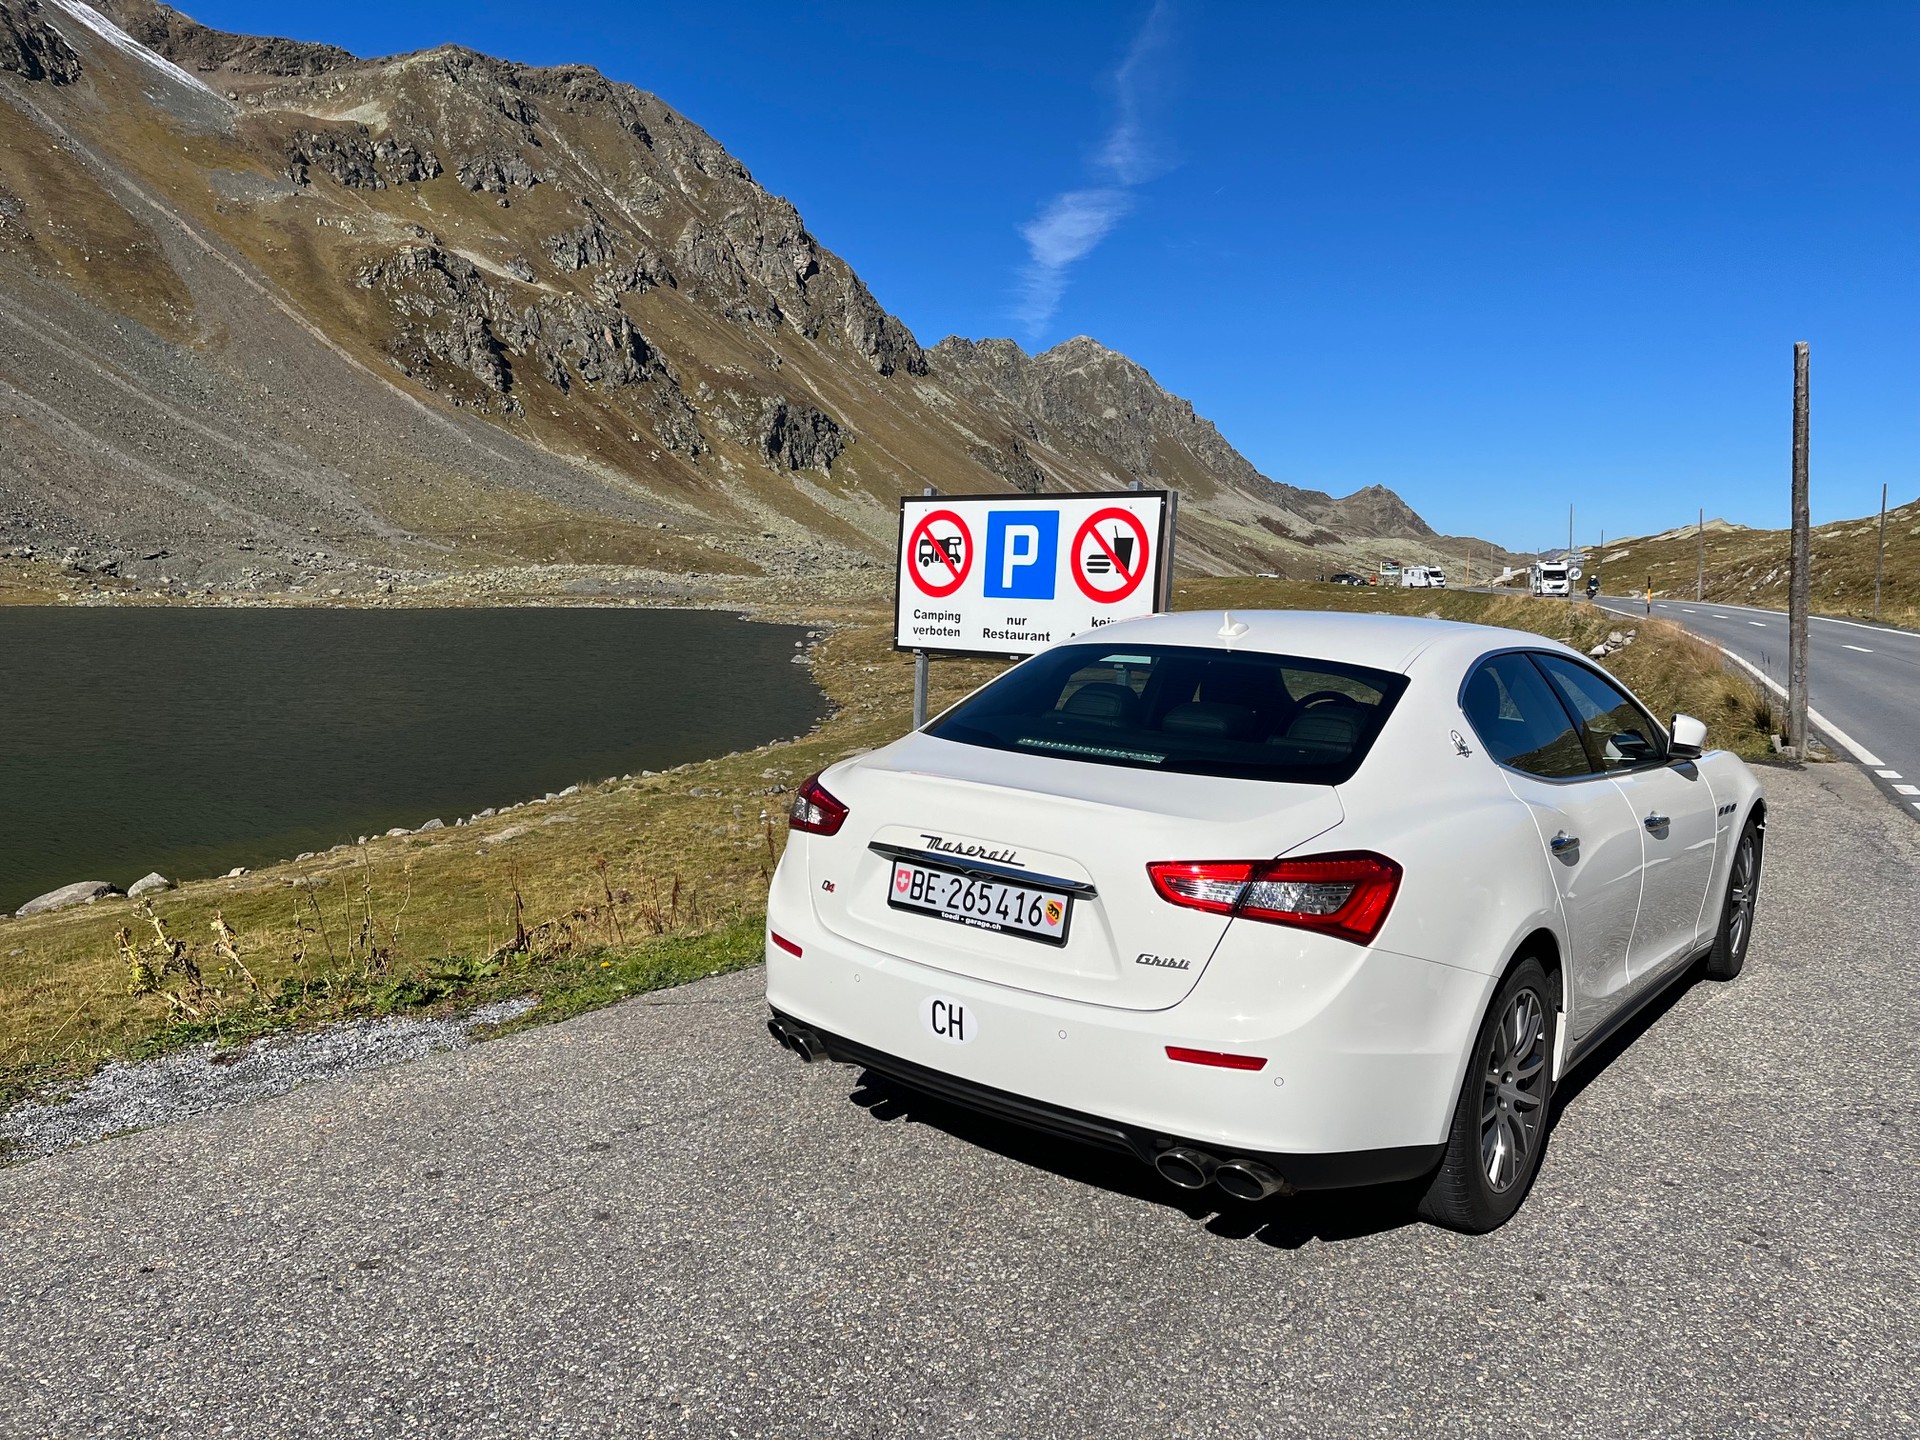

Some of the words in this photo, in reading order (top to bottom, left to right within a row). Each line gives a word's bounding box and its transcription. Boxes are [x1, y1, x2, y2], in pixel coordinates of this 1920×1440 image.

[1002, 524, 1039, 589] P
[913, 609, 961, 624] Camping
[1006, 615, 1027, 626] nur
[1091, 616, 1117, 628] kei
[913, 625, 961, 638] verboten
[983, 628, 1050, 642] Restaurant
[920, 834, 1025, 867] Maserati
[941, 911, 960, 922] toedi
[965, 917, 1002, 931] garage.ch
[1135, 953, 1191, 970] Ghibli
[931, 999, 965, 1041] CH
